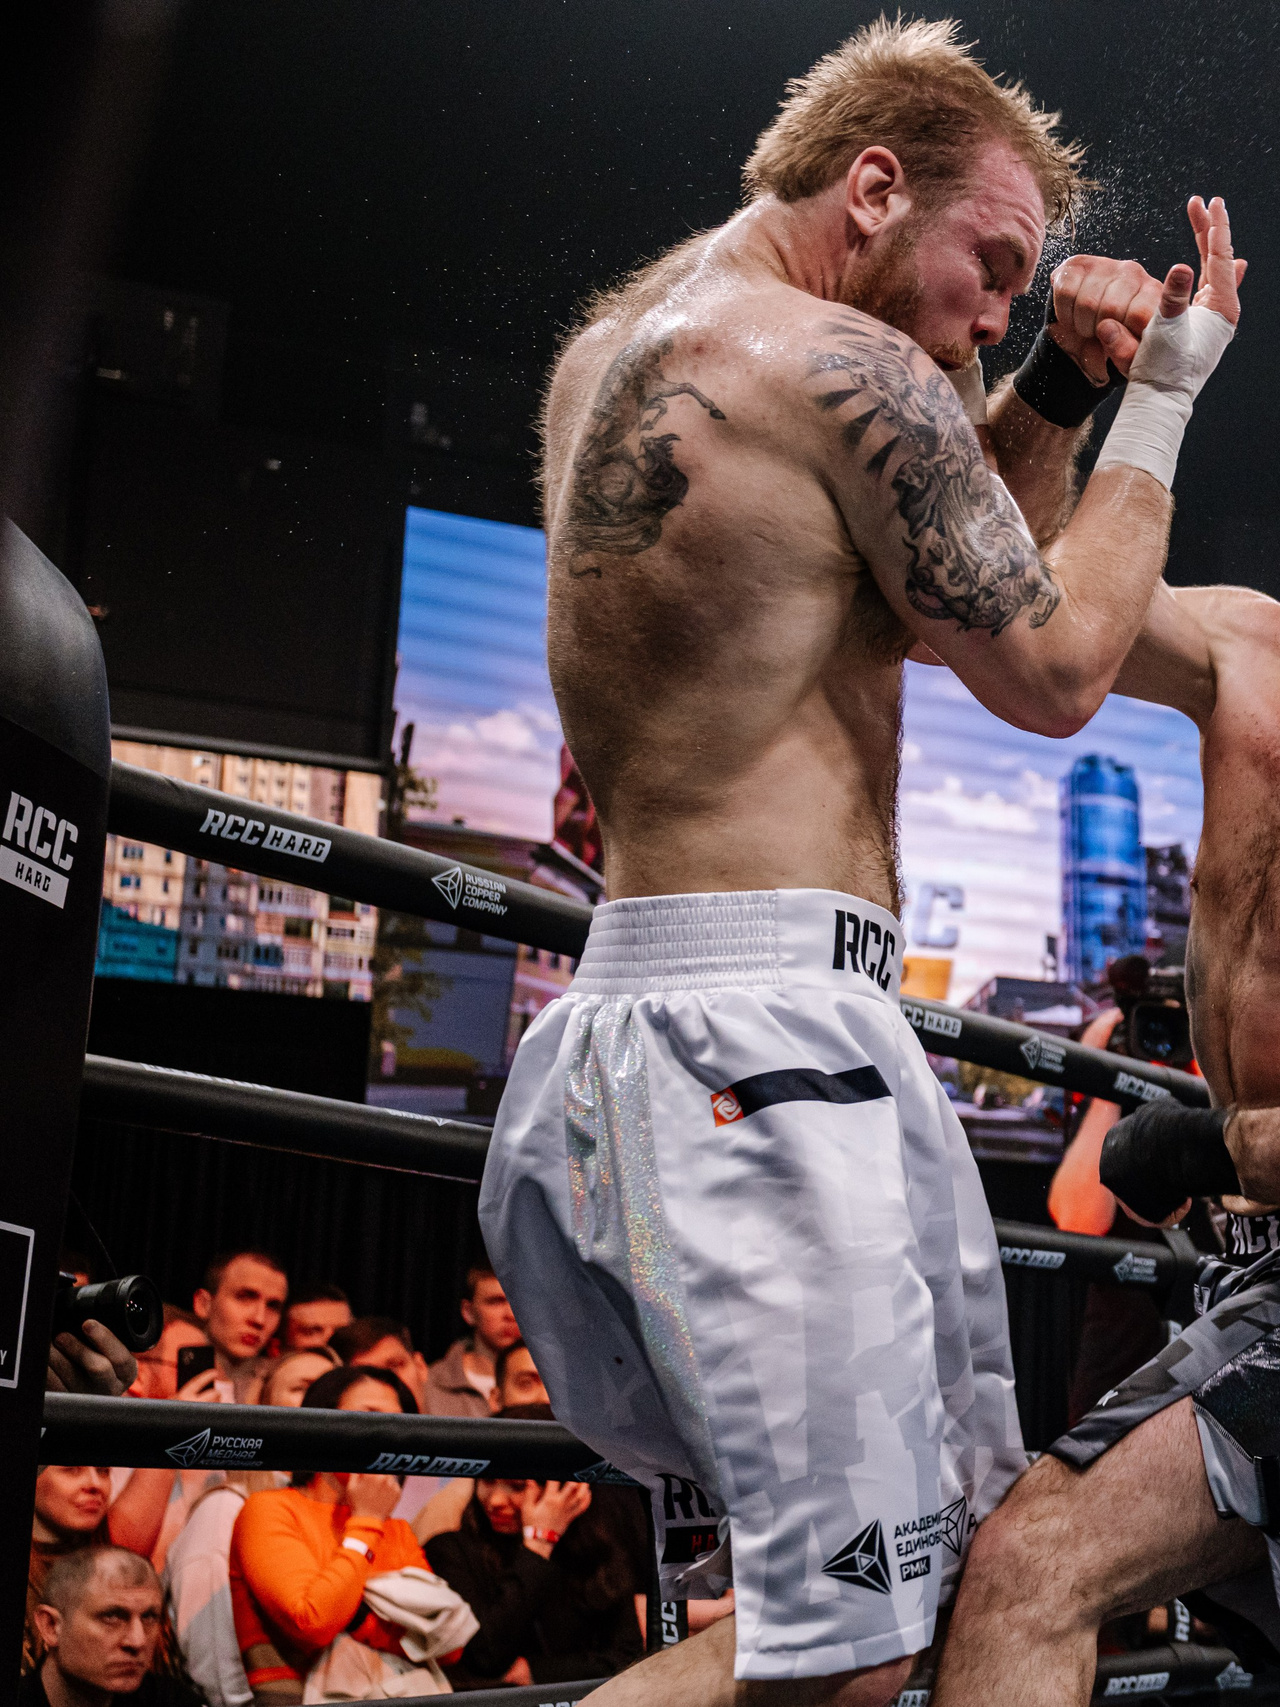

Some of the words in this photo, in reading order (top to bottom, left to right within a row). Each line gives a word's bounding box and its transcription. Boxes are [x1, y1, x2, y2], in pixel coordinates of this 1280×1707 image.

[2, 791, 78, 871] RCC
[200, 808, 265, 845] RCC
[268, 825, 327, 857] HARD
[15, 861, 52, 892] HARD
[465, 873, 507, 893] RUSSIAN
[465, 885, 501, 902] COPPER
[462, 895, 508, 916] COMPANY
[832, 909, 896, 992] RCC
[211, 1435, 264, 1450] РУССКАЯ
[206, 1448, 257, 1460] МЕДНАЯ
[367, 1453, 430, 1472] RCC
[902, 1559, 928, 1580] РМК
[661, 1601, 679, 1650] CC
